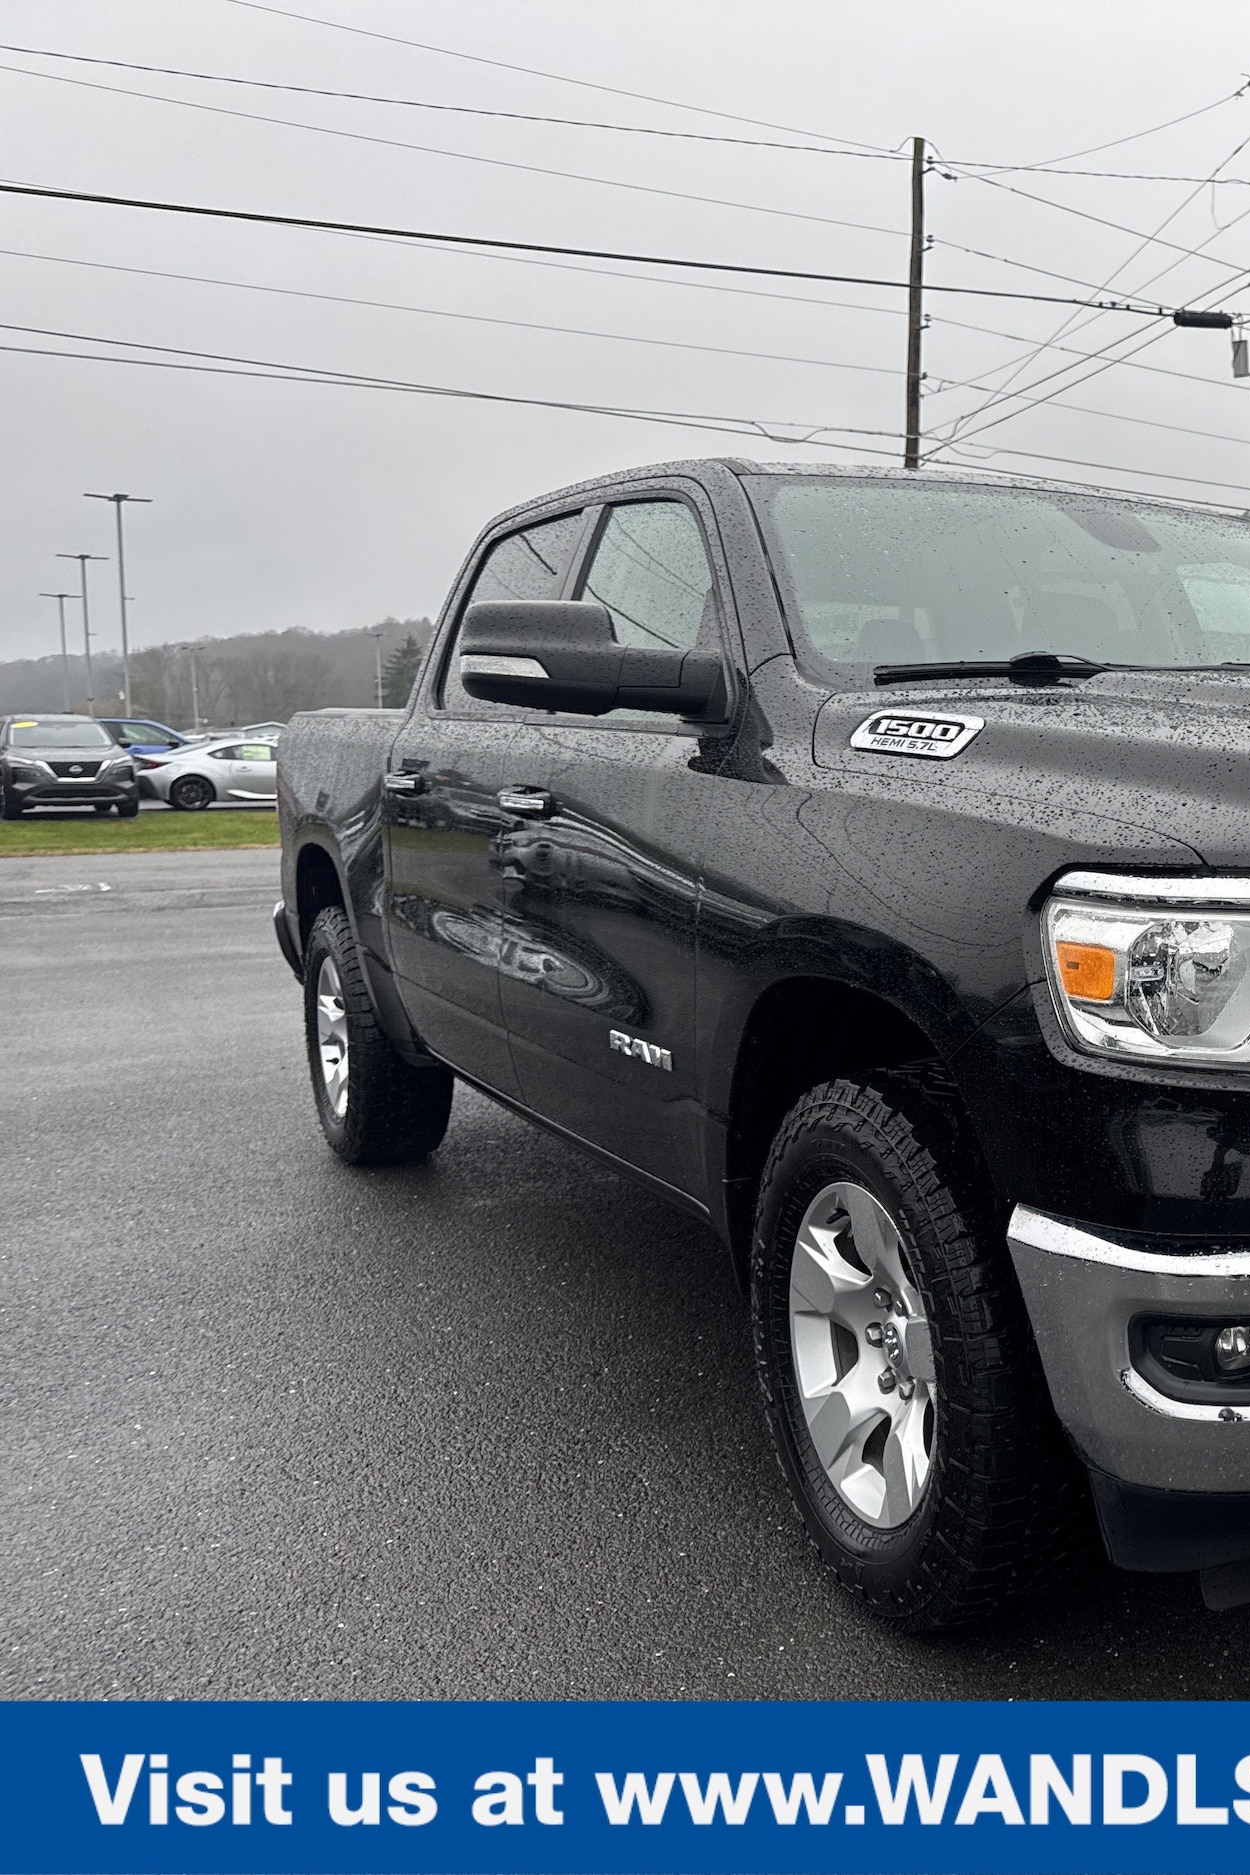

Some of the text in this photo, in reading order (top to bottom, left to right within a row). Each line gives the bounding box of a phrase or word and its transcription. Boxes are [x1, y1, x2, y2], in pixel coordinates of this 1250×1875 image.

[876, 719, 960, 740] 1500
[870, 737, 937, 751] HEMI 5.7L
[609, 1029, 673, 1072] RAM
